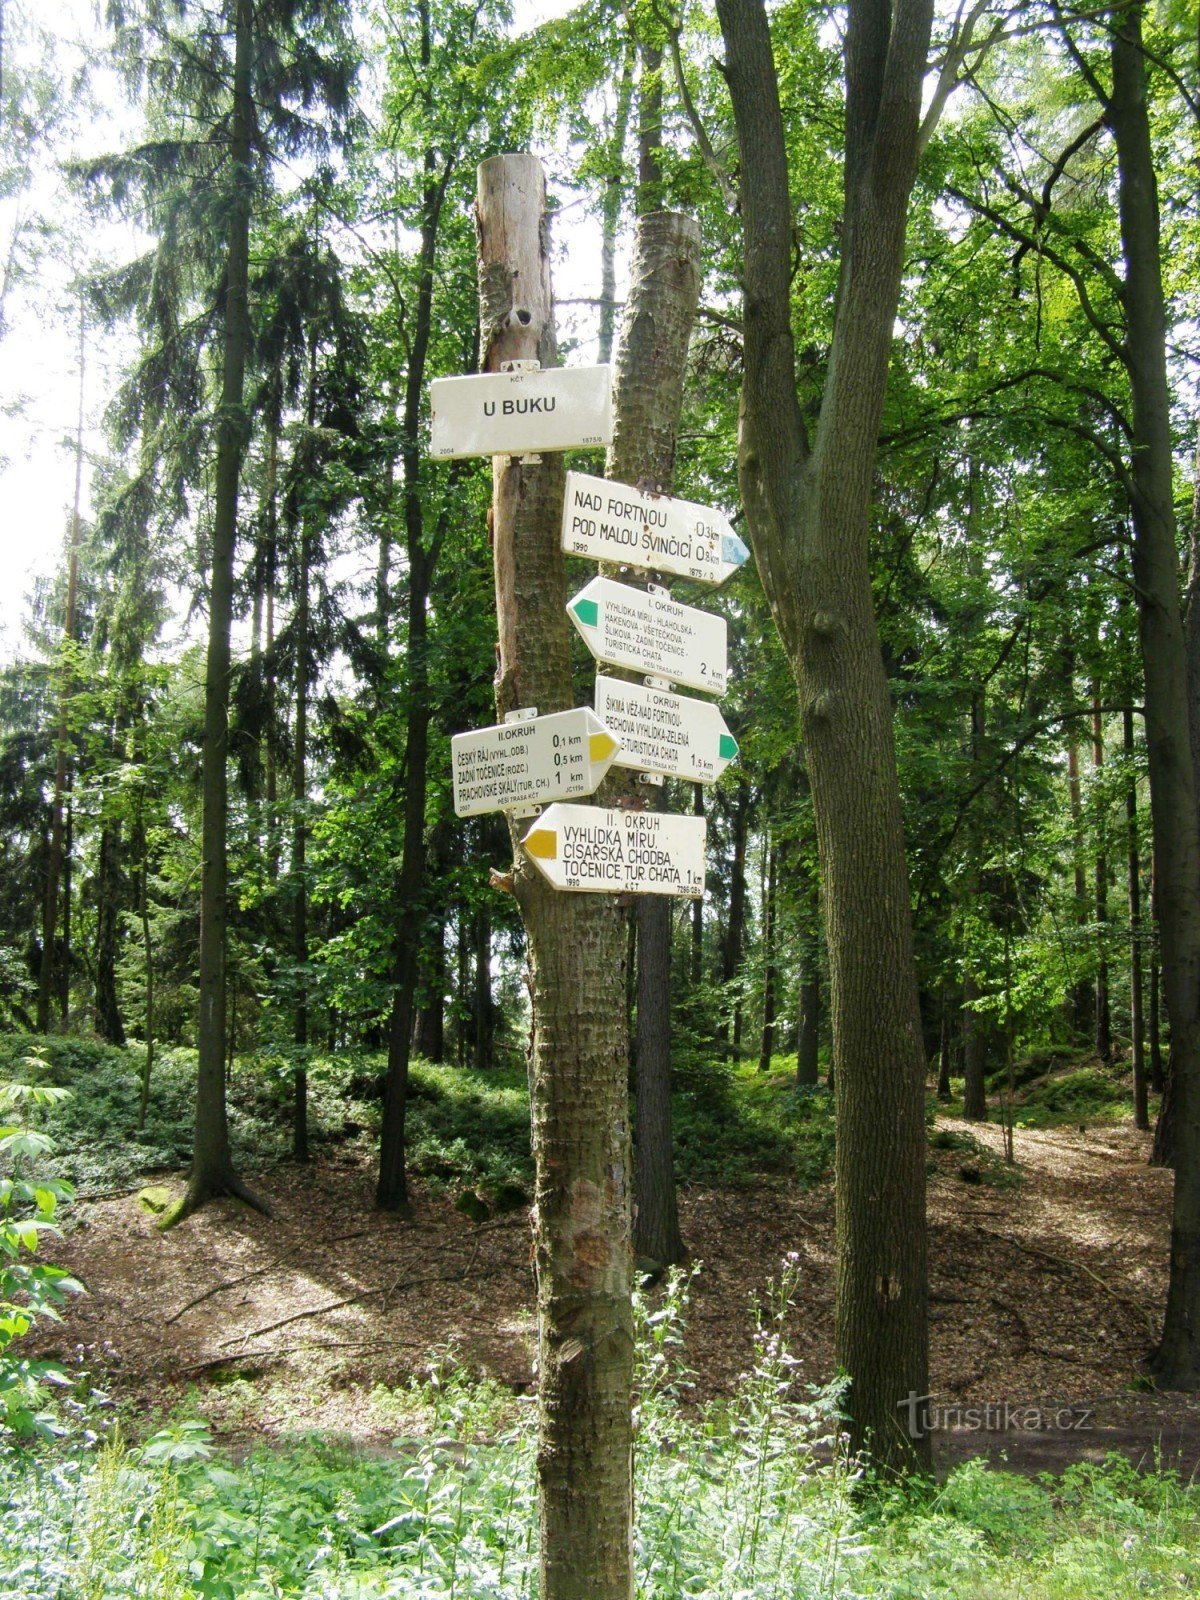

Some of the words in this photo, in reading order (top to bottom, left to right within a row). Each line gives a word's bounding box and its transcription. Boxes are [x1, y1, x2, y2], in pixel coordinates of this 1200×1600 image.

[484, 402, 496, 416] U
[503, 397, 556, 415] BUKU
[575, 491, 602, 512] NAD
[608, 499, 667, 528] FORTNOU
[572, 517, 596, 537] POD
[600, 524, 638, 547] MALOU
[573, 542, 588, 552] 1990
[606, 601, 636, 617] VYHLÍDKA
[637, 610, 652, 623] MÍRU
[657, 618, 692, 635] HLAHOLSKÁ
[655, 601, 684, 617] OKRUH
[605, 614, 639, 630] HAKENOVA
[643, 625, 682, 644] VŠETEČKOVA
[605, 624, 631, 640] ŠLIKOVA
[636, 635, 654, 647] ZADNÍ
[656, 640, 685, 657] TOČENICE
[605, 638, 641, 655] TURISTICKÁ
[643, 649, 662, 661] CHATA
[701, 663, 707, 675] 2
[712, 670, 723, 680] km
[606, 694, 625, 713] ŠIKMÁ
[653, 696, 680, 710] OKRUH
[606, 716, 635, 735] PECHOVA
[569, 736, 582, 744] km
[458, 749, 476, 767] ČESKÝ
[478, 747, 489, 762] RÁJ
[570, 754, 583, 763] km
[661, 746, 679, 762] CHATA
[459, 765, 475, 784] ZADNÍ
[476, 763, 505, 781] TOČENICE
[704, 759, 714, 770] km
[555, 771, 561, 784] 1
[571, 772, 583, 782] km
[459, 781, 497, 802] PRACHOVSKÉ
[625, 816, 660, 831] OKRUH
[564, 826, 622, 847] VYHLÍDKA
[564, 842, 624, 863] CÍSAŘSKÁ
[566, 879, 580, 887] 1990
[650, 867, 681, 883] CHATA
[687, 870, 691, 885] 1
[693, 874, 702, 886] km
